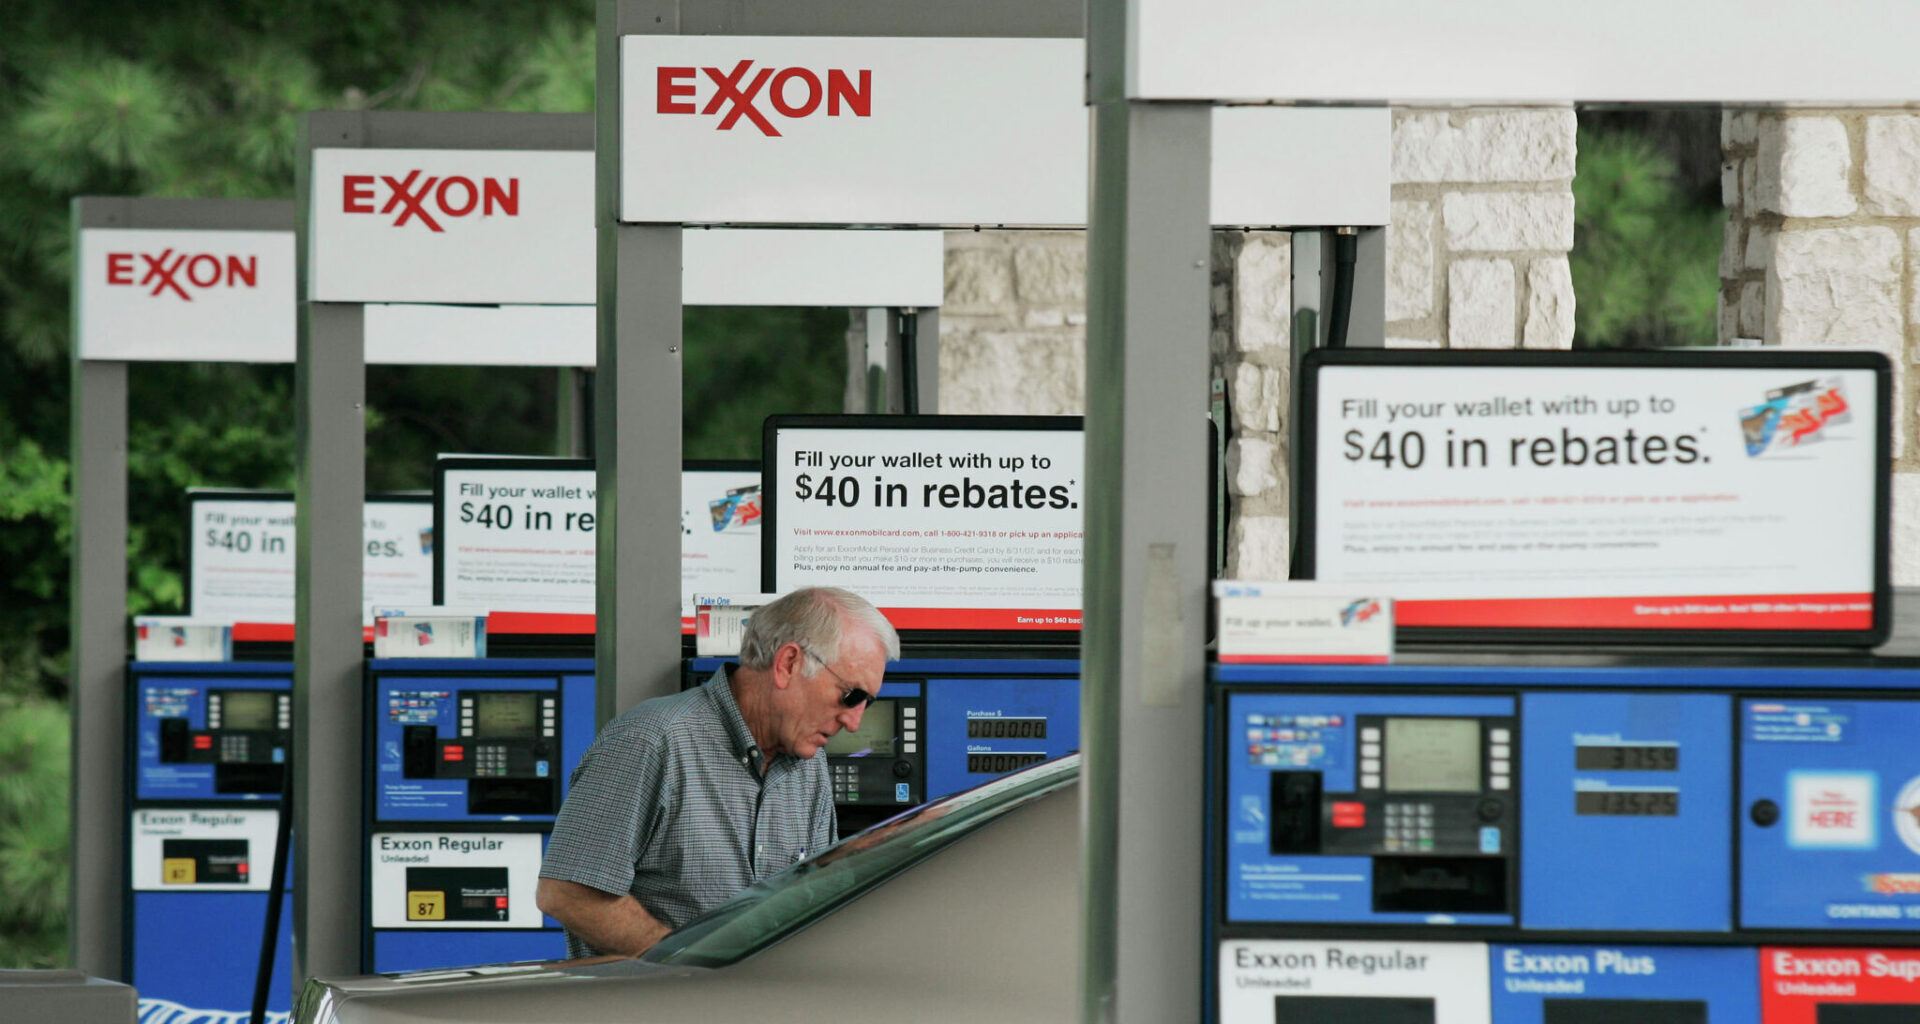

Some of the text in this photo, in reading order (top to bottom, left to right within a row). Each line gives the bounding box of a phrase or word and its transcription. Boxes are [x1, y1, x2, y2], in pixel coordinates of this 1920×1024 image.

[657, 60, 872, 137] EXXON
[343, 170, 519, 232] EXXON
[107, 249, 257, 301] EXXON
[1342, 395, 1676, 423] Fill your wallet with up to
[1344, 427, 1710, 469] $40 in rebates.
[795, 451, 1052, 472] Fill your wallet with up to
[460, 483, 484, 497] Fill
[488, 486, 527, 500] your
[531, 485, 582, 500] wallet
[795, 473, 1078, 509] $40 in rebates.
[460, 502, 513, 530] $40
[525, 504, 552, 531] in
[206, 528, 285, 553] $40 in
[793, 528, 812, 537] Visit
[924, 529, 939, 537] call
[1009, 530, 1026, 539] pick
[1028, 532, 1039, 540] up
[1041, 531, 1051, 539] an
[1053, 530, 1083, 540] applica
[793, 563, 814, 571] Plus,
[816, 564, 838, 572] enjoy
[913, 565, 983, 573] pay-at-the-pump
[1016, 616, 1034, 624] Earn
[1034, 617, 1044, 625] up
[1045, 616, 1053, 624] to
[1068, 616, 1083, 624] bac
[381, 837, 504, 854] Exxon Regular
[381, 855, 429, 864] Unleaded
[418, 902, 435, 916] 87
[1235, 948, 1428, 975] Exxon Regular
[1504, 950, 1655, 975] Exxon Plus
[1774, 952, 1861, 977] Exxon
[1236, 976, 1311, 989] Unleaded
[1505, 979, 1585, 994] Unleaded
[1776, 981, 1856, 997] Unleaded
